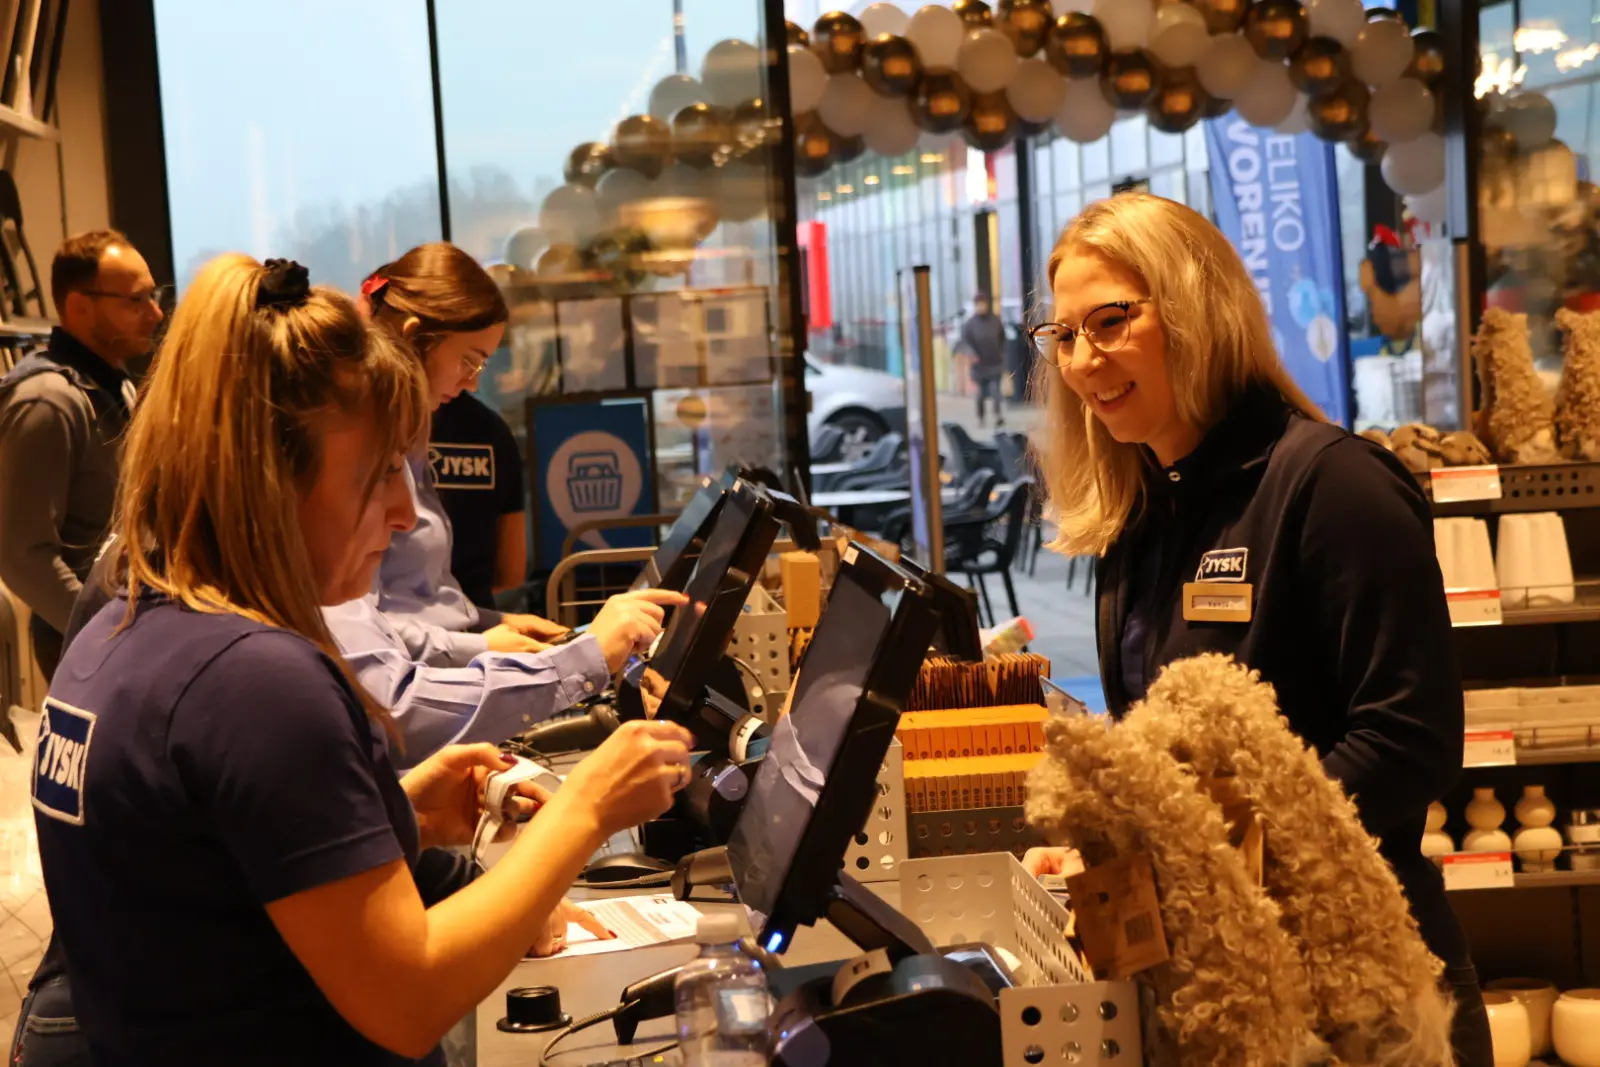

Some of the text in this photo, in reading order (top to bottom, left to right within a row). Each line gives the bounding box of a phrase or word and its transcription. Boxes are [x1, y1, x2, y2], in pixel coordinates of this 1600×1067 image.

[441, 455, 490, 477] JYSK
[1205, 556, 1243, 574] JYSK
[39, 731, 85, 791] JYSK
